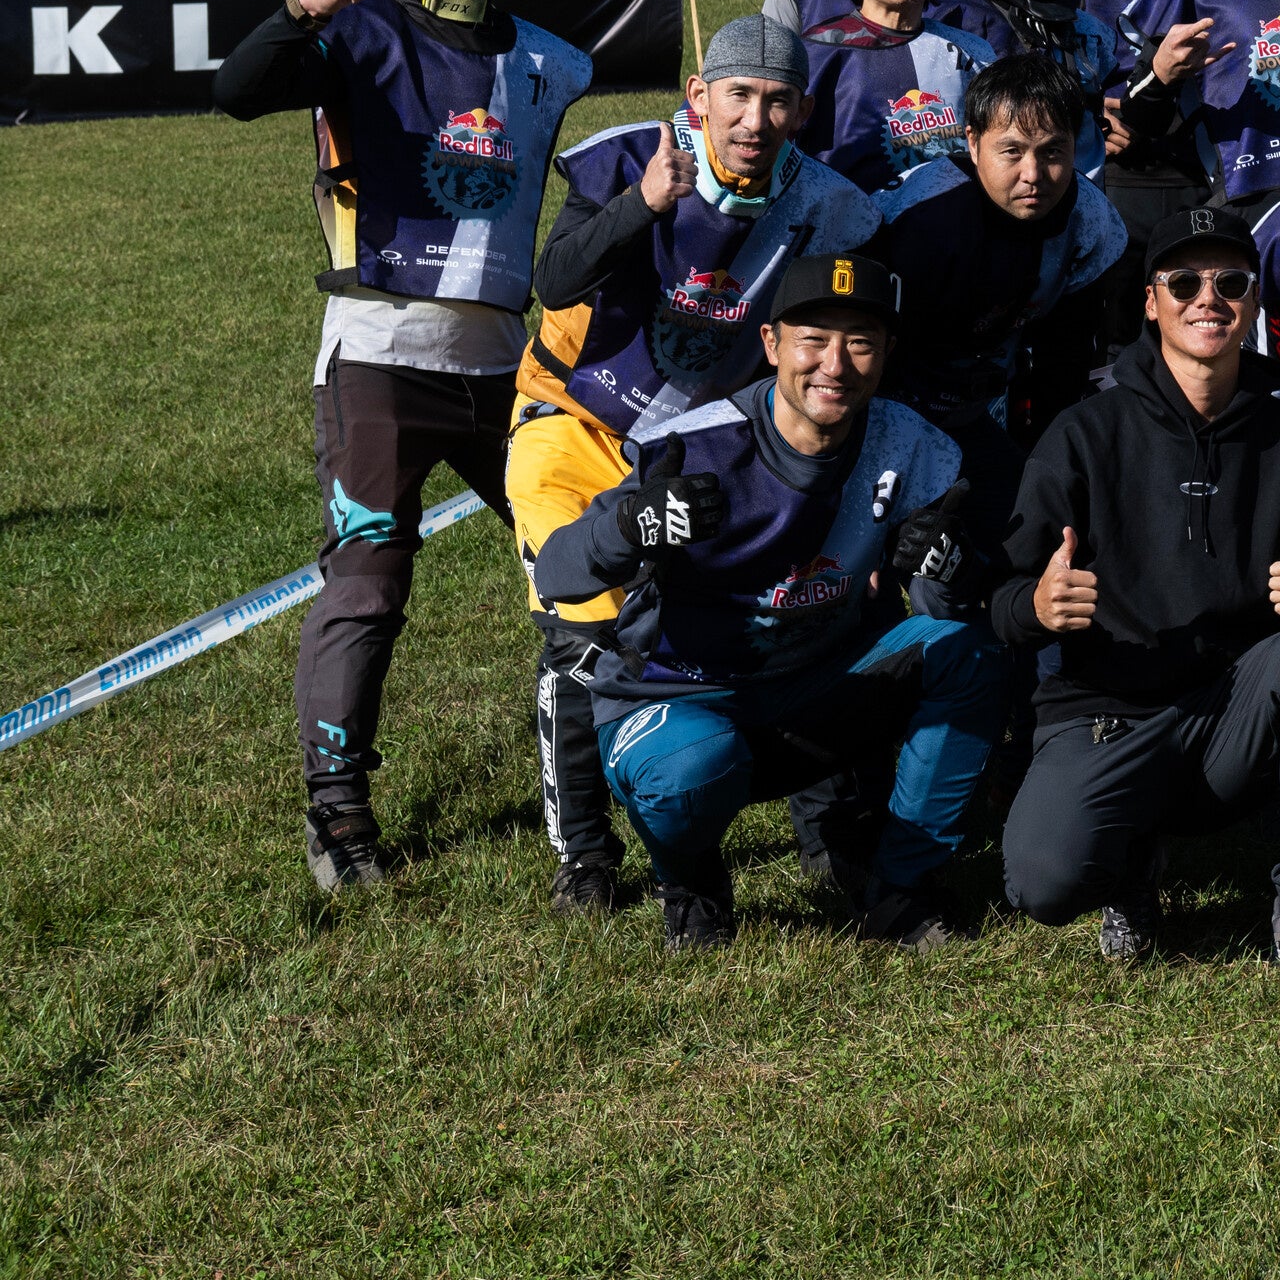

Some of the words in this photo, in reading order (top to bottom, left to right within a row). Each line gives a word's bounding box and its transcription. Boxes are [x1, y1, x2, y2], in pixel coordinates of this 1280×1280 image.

[440, 1, 471, 14] FOX
[888, 117, 924, 138] Red
[924, 107, 957, 131] Bull
[439, 132, 479, 157] Red
[480, 137, 514, 161] Bull
[891, 124, 963, 150] DOWNTIME
[415, 257, 459, 268] SHIMANO
[425, 244, 507, 262] DEFENDER
[670, 289, 711, 319] Red
[711, 298, 751, 322] Bull
[620, 393, 657, 420] SHIMANO
[666, 488, 692, 547] FOX
[771, 584, 811, 609] Red
[811, 574, 853, 604] Bull
